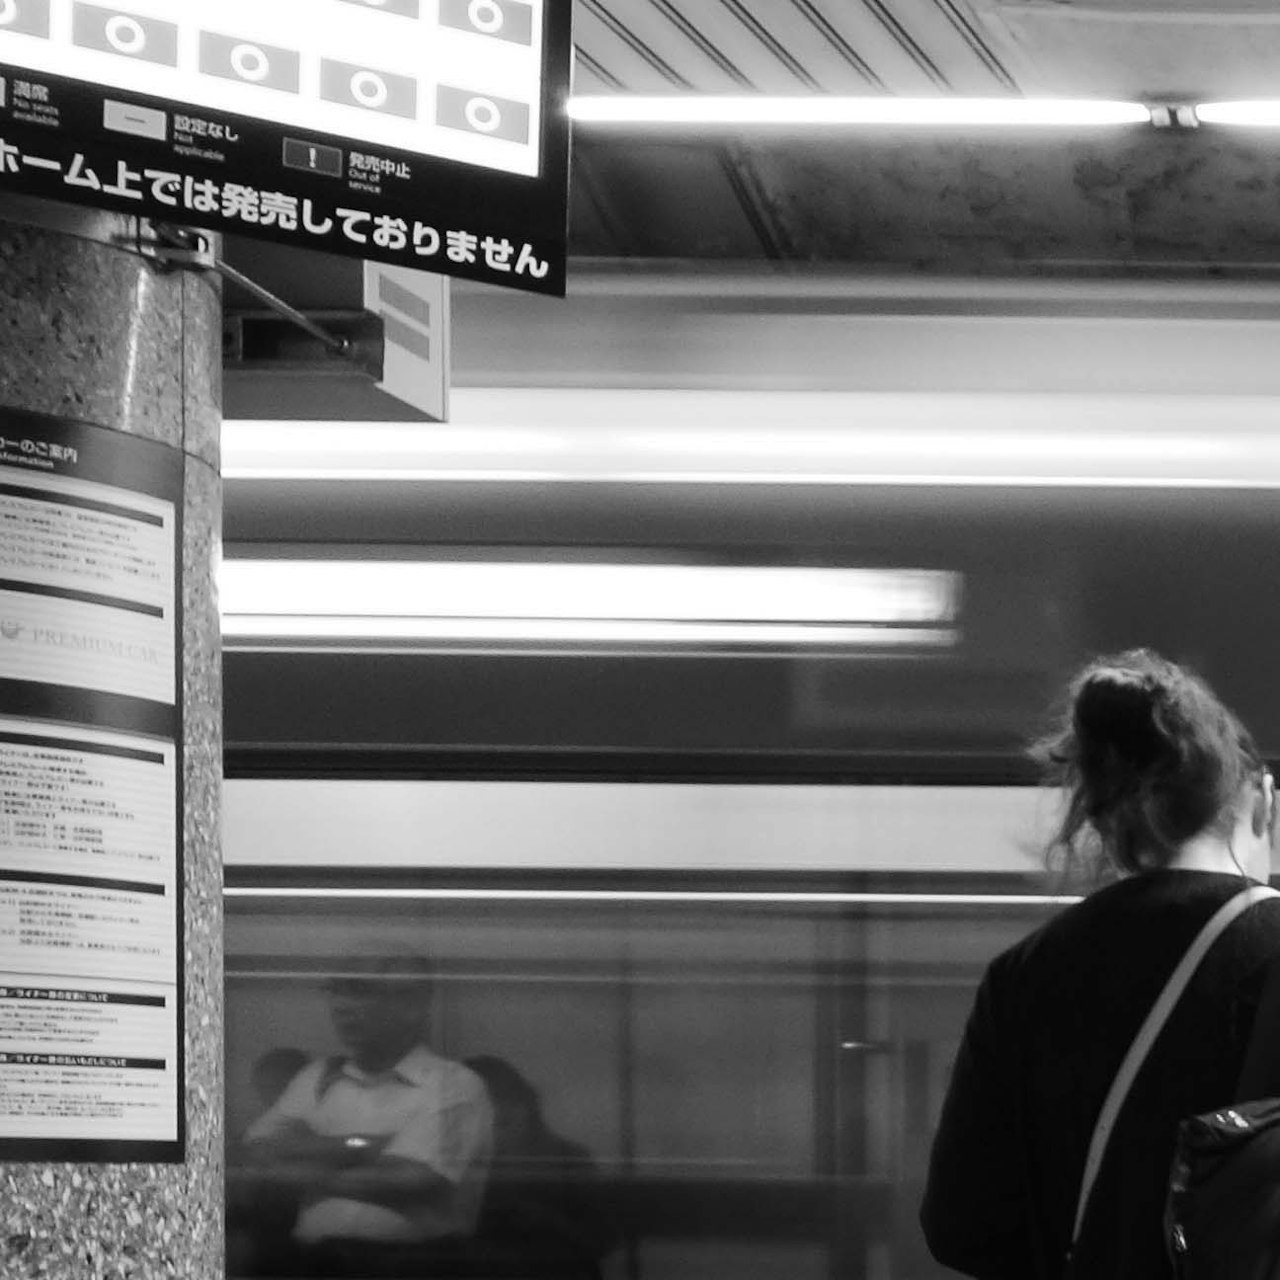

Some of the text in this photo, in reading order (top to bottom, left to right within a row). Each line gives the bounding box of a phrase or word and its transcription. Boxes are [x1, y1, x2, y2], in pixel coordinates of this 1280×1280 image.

[173, 114, 239, 142] 設定なし
[348, 151, 411, 180] 発売中止
[348, 167, 367, 180] Out
[0, 436, 78, 464] ーのご案内
